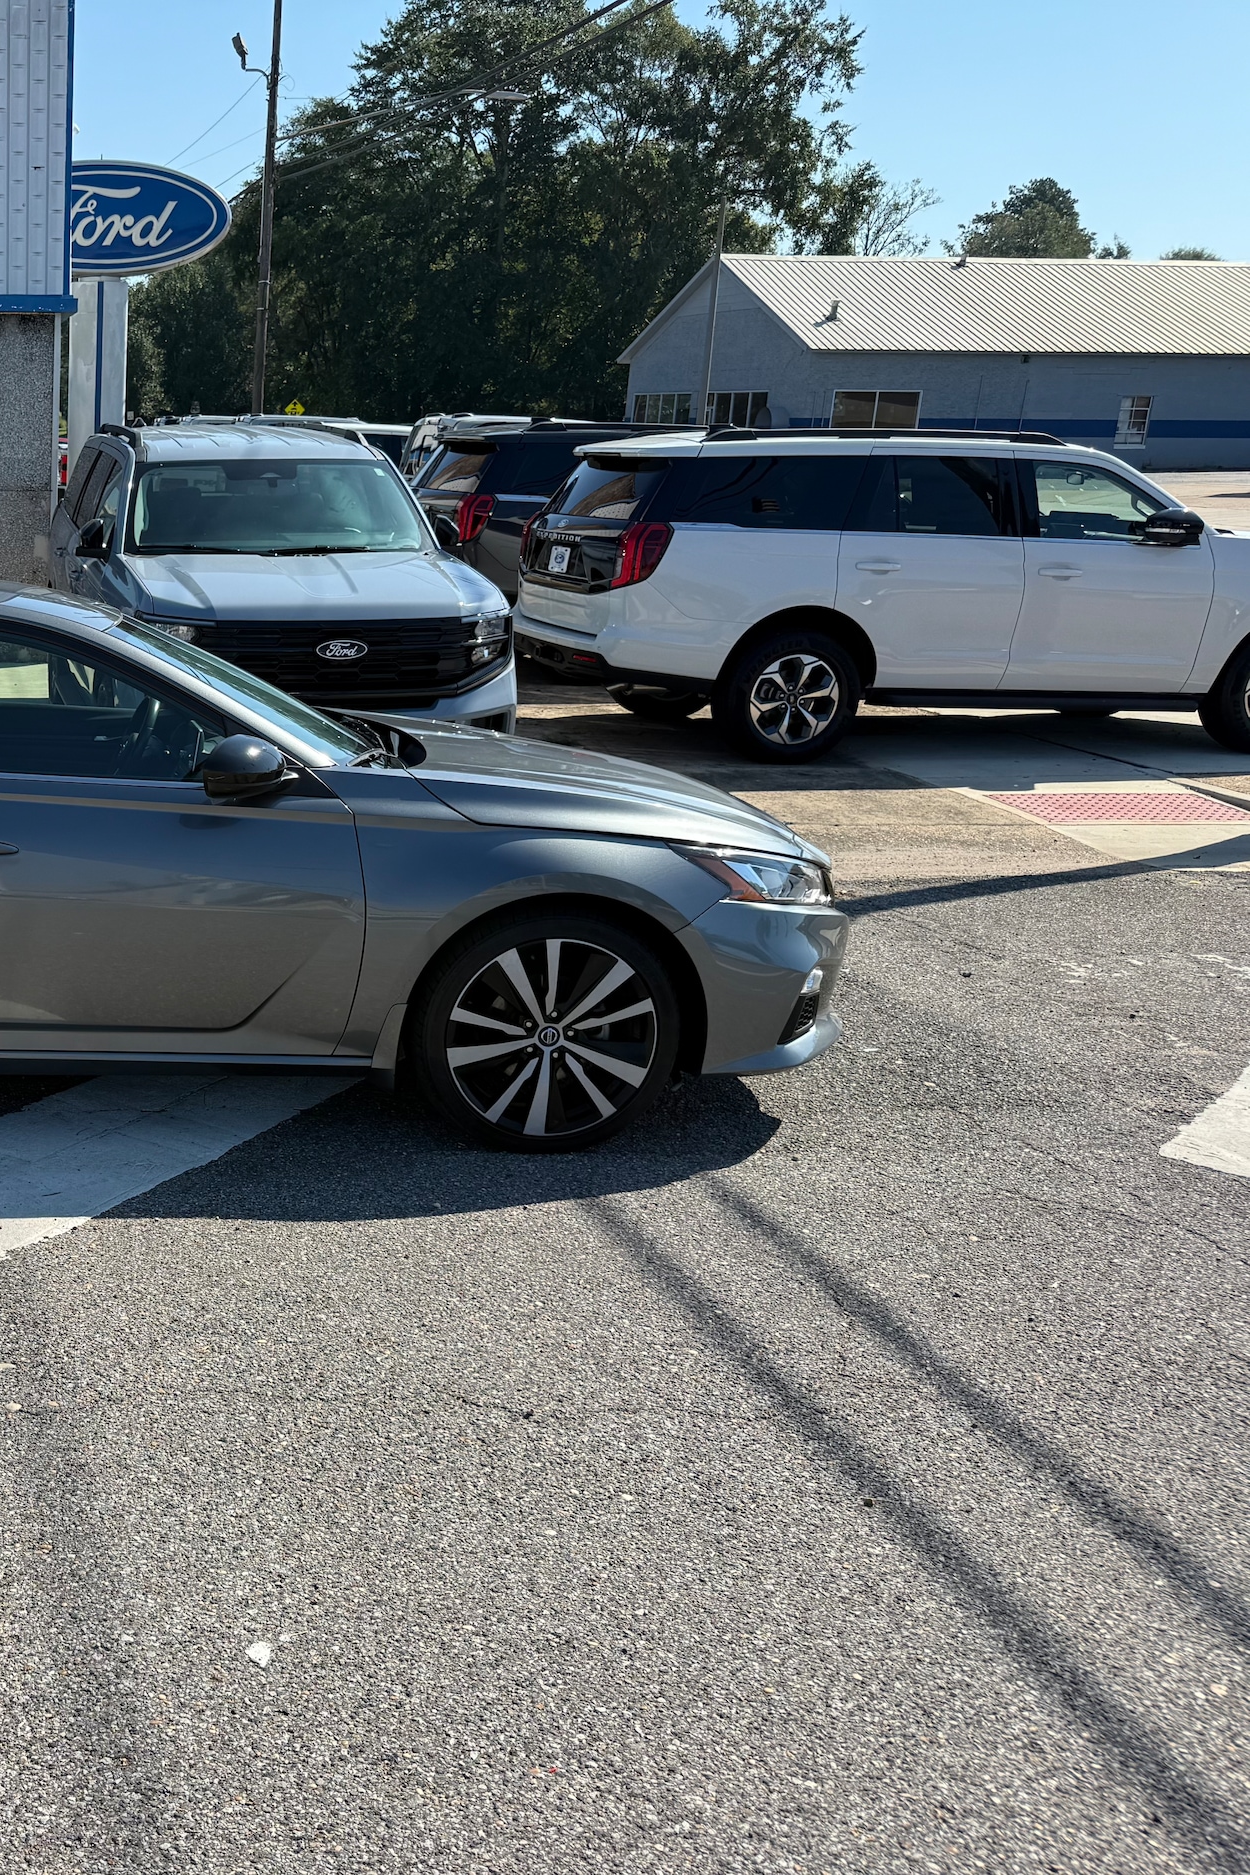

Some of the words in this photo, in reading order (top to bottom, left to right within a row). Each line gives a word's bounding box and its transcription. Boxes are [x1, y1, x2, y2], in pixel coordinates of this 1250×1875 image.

[72, 184, 178, 247] Ford
[536, 530, 581, 543] EXPEDITION
[325, 642, 359, 656] Ford
